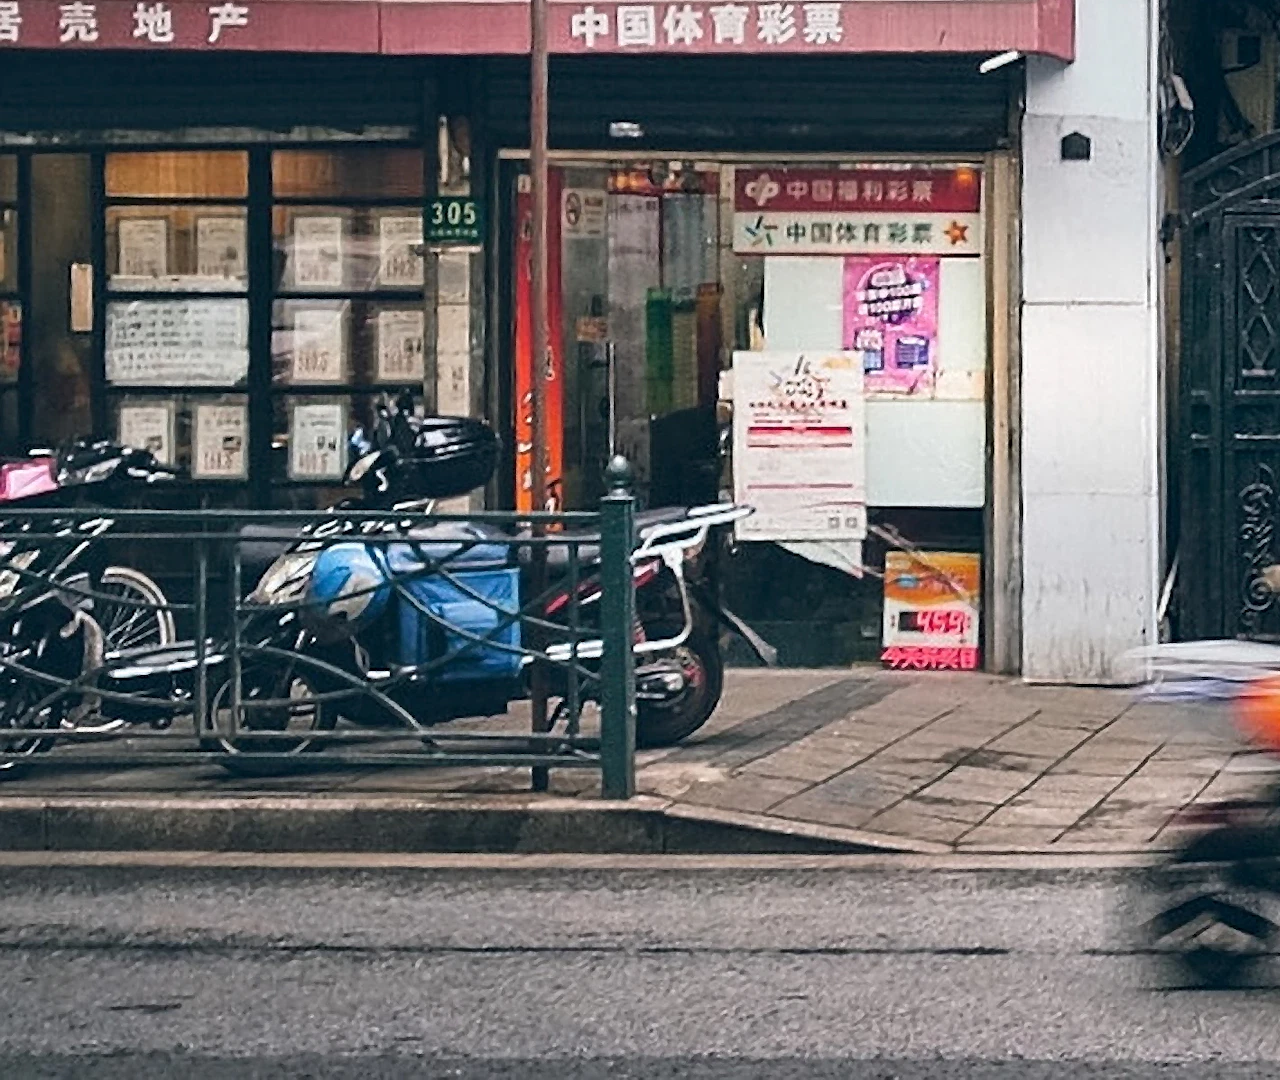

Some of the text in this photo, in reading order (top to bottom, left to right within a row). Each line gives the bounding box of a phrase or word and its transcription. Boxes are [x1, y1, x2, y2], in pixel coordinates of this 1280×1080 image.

[571, 3, 843, 46] 中国体育彩票
[786, 179, 933, 204] 中国福利彩票
[431, 202, 476, 225] 305
[786, 221, 933, 245] 中国体育彩票
